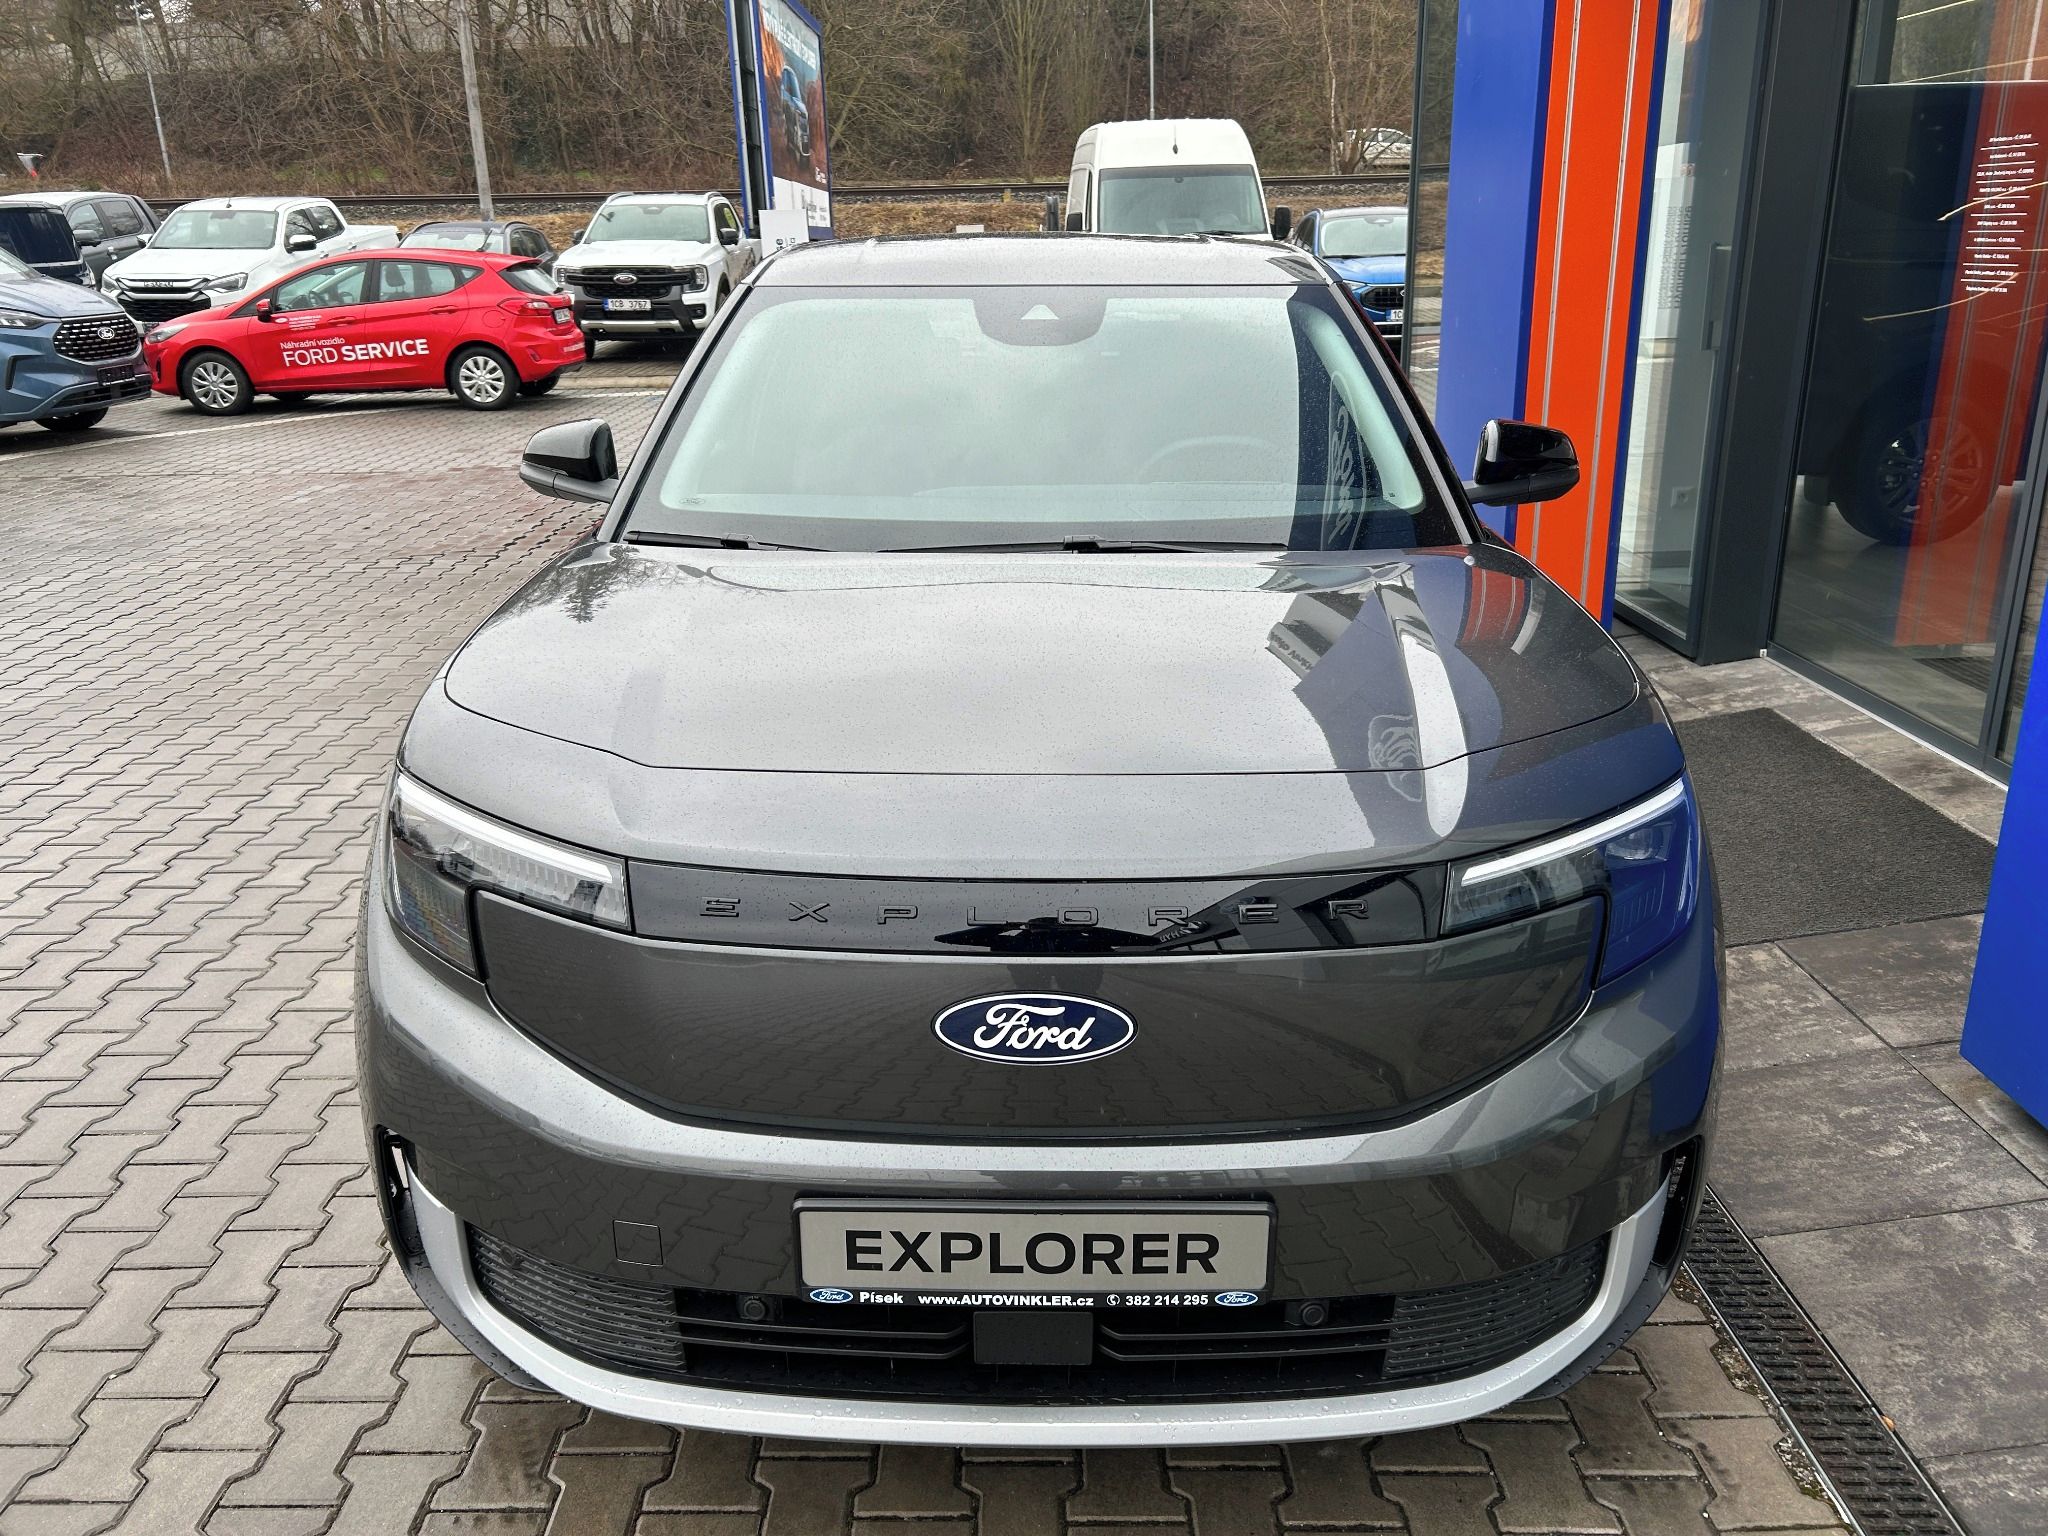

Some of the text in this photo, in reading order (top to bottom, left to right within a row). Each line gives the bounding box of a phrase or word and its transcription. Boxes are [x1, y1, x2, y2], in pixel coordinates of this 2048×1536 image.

[280, 336, 345, 350] Náhradní vozidlo
[283, 338, 430, 367] FORD SERVICE
[699, 896, 1369, 927] EXPLORER
[973, 1003, 1095, 1050] Ford
[845, 1229, 1220, 1275] EXPLORER
[860, 1291, 904, 1304] Písek
[918, 1294, 1095, 1307] www.AUTOVINKLER.cz
[1125, 1294, 1150, 1306] 382
[1154, 1294, 1179, 1306] 214
[1183, 1294, 1208, 1306] 295
